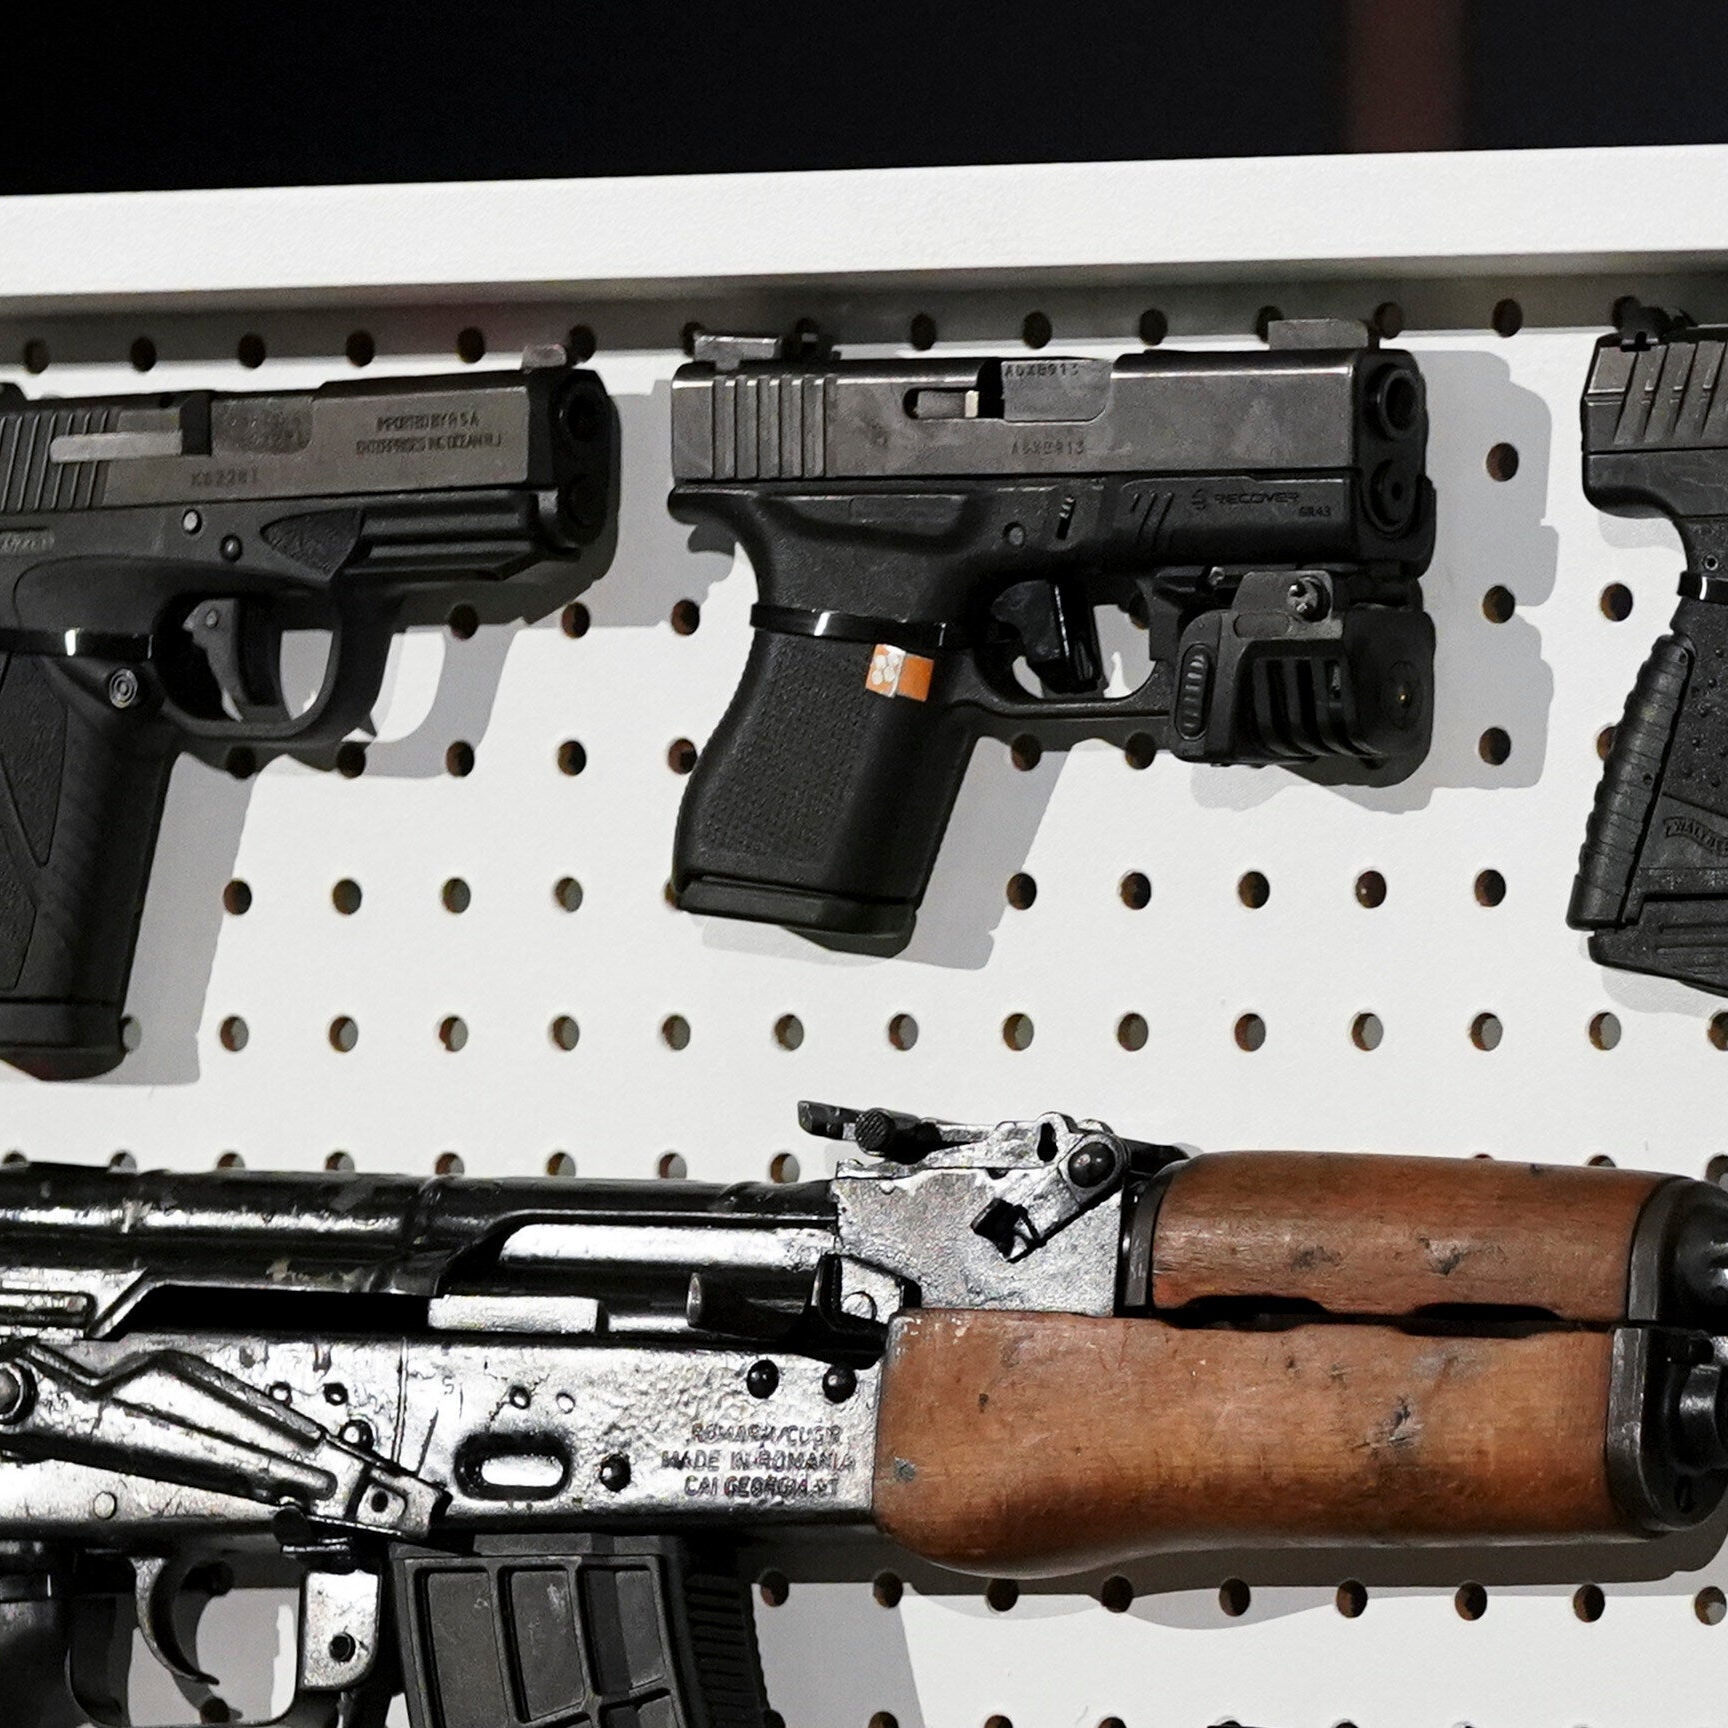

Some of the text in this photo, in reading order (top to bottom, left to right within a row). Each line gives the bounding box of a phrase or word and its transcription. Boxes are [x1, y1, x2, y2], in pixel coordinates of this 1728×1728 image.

[1214, 491, 1300, 505] RECOVER
[661, 1448, 721, 1472] MADE
[757, 1449, 856, 1473] ROMANIA
[683, 1475, 719, 1498] CAI
